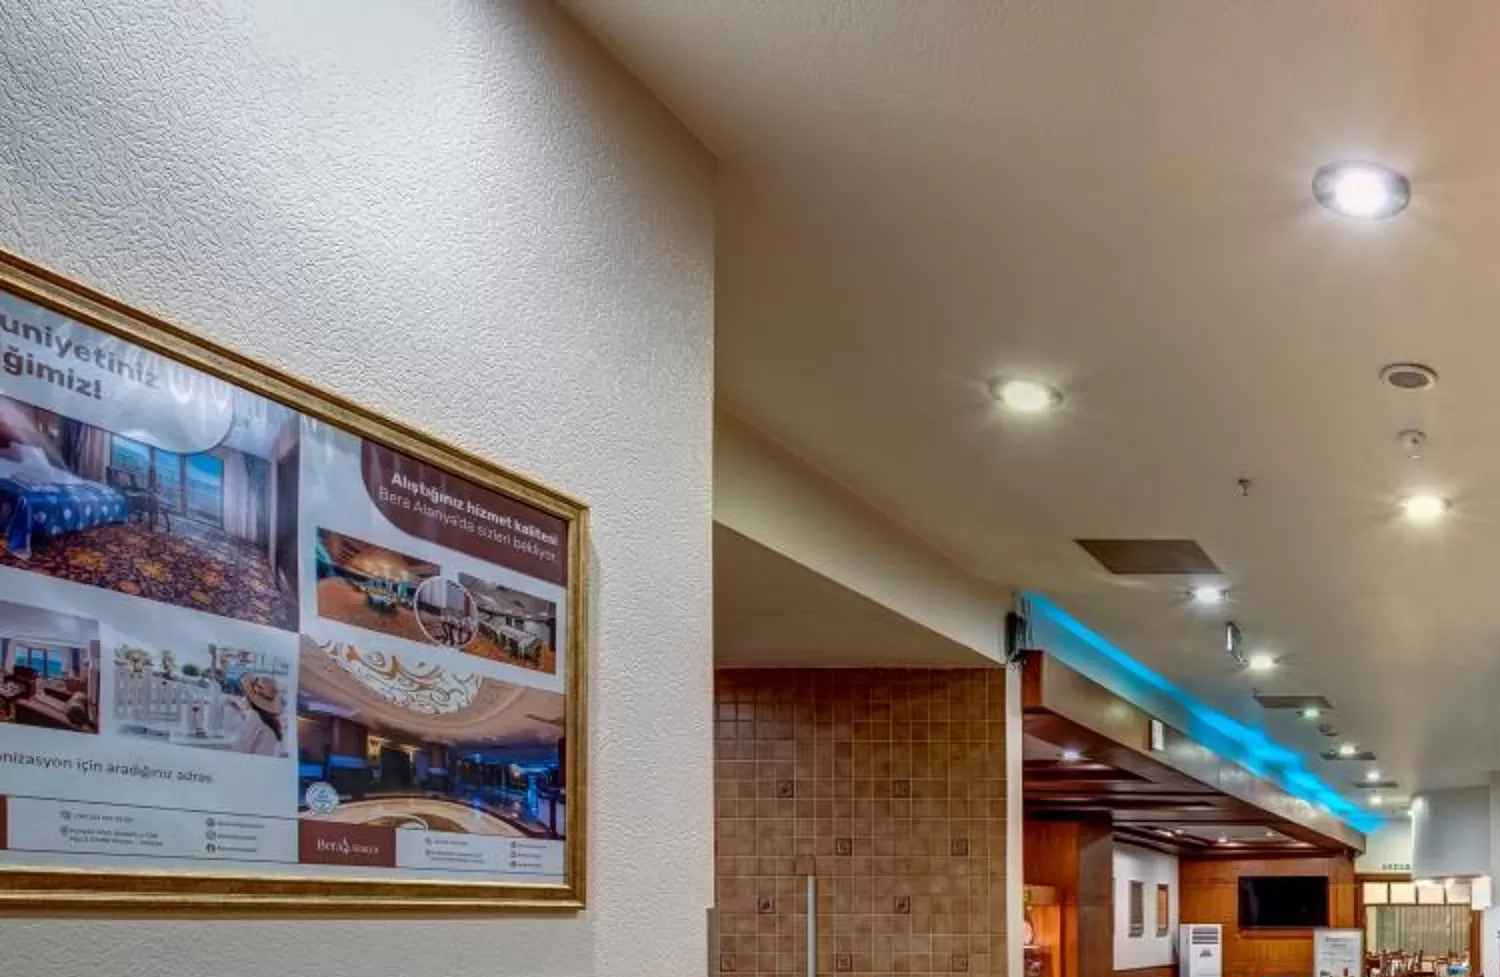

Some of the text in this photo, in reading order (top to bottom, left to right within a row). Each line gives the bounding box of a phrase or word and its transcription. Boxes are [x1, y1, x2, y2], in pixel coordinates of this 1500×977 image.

[466, 501, 513, 530] hizmet
[0, 753, 73, 771] nizasyon
[76, 758, 103, 777] için
[177, 769, 214, 784] adres
